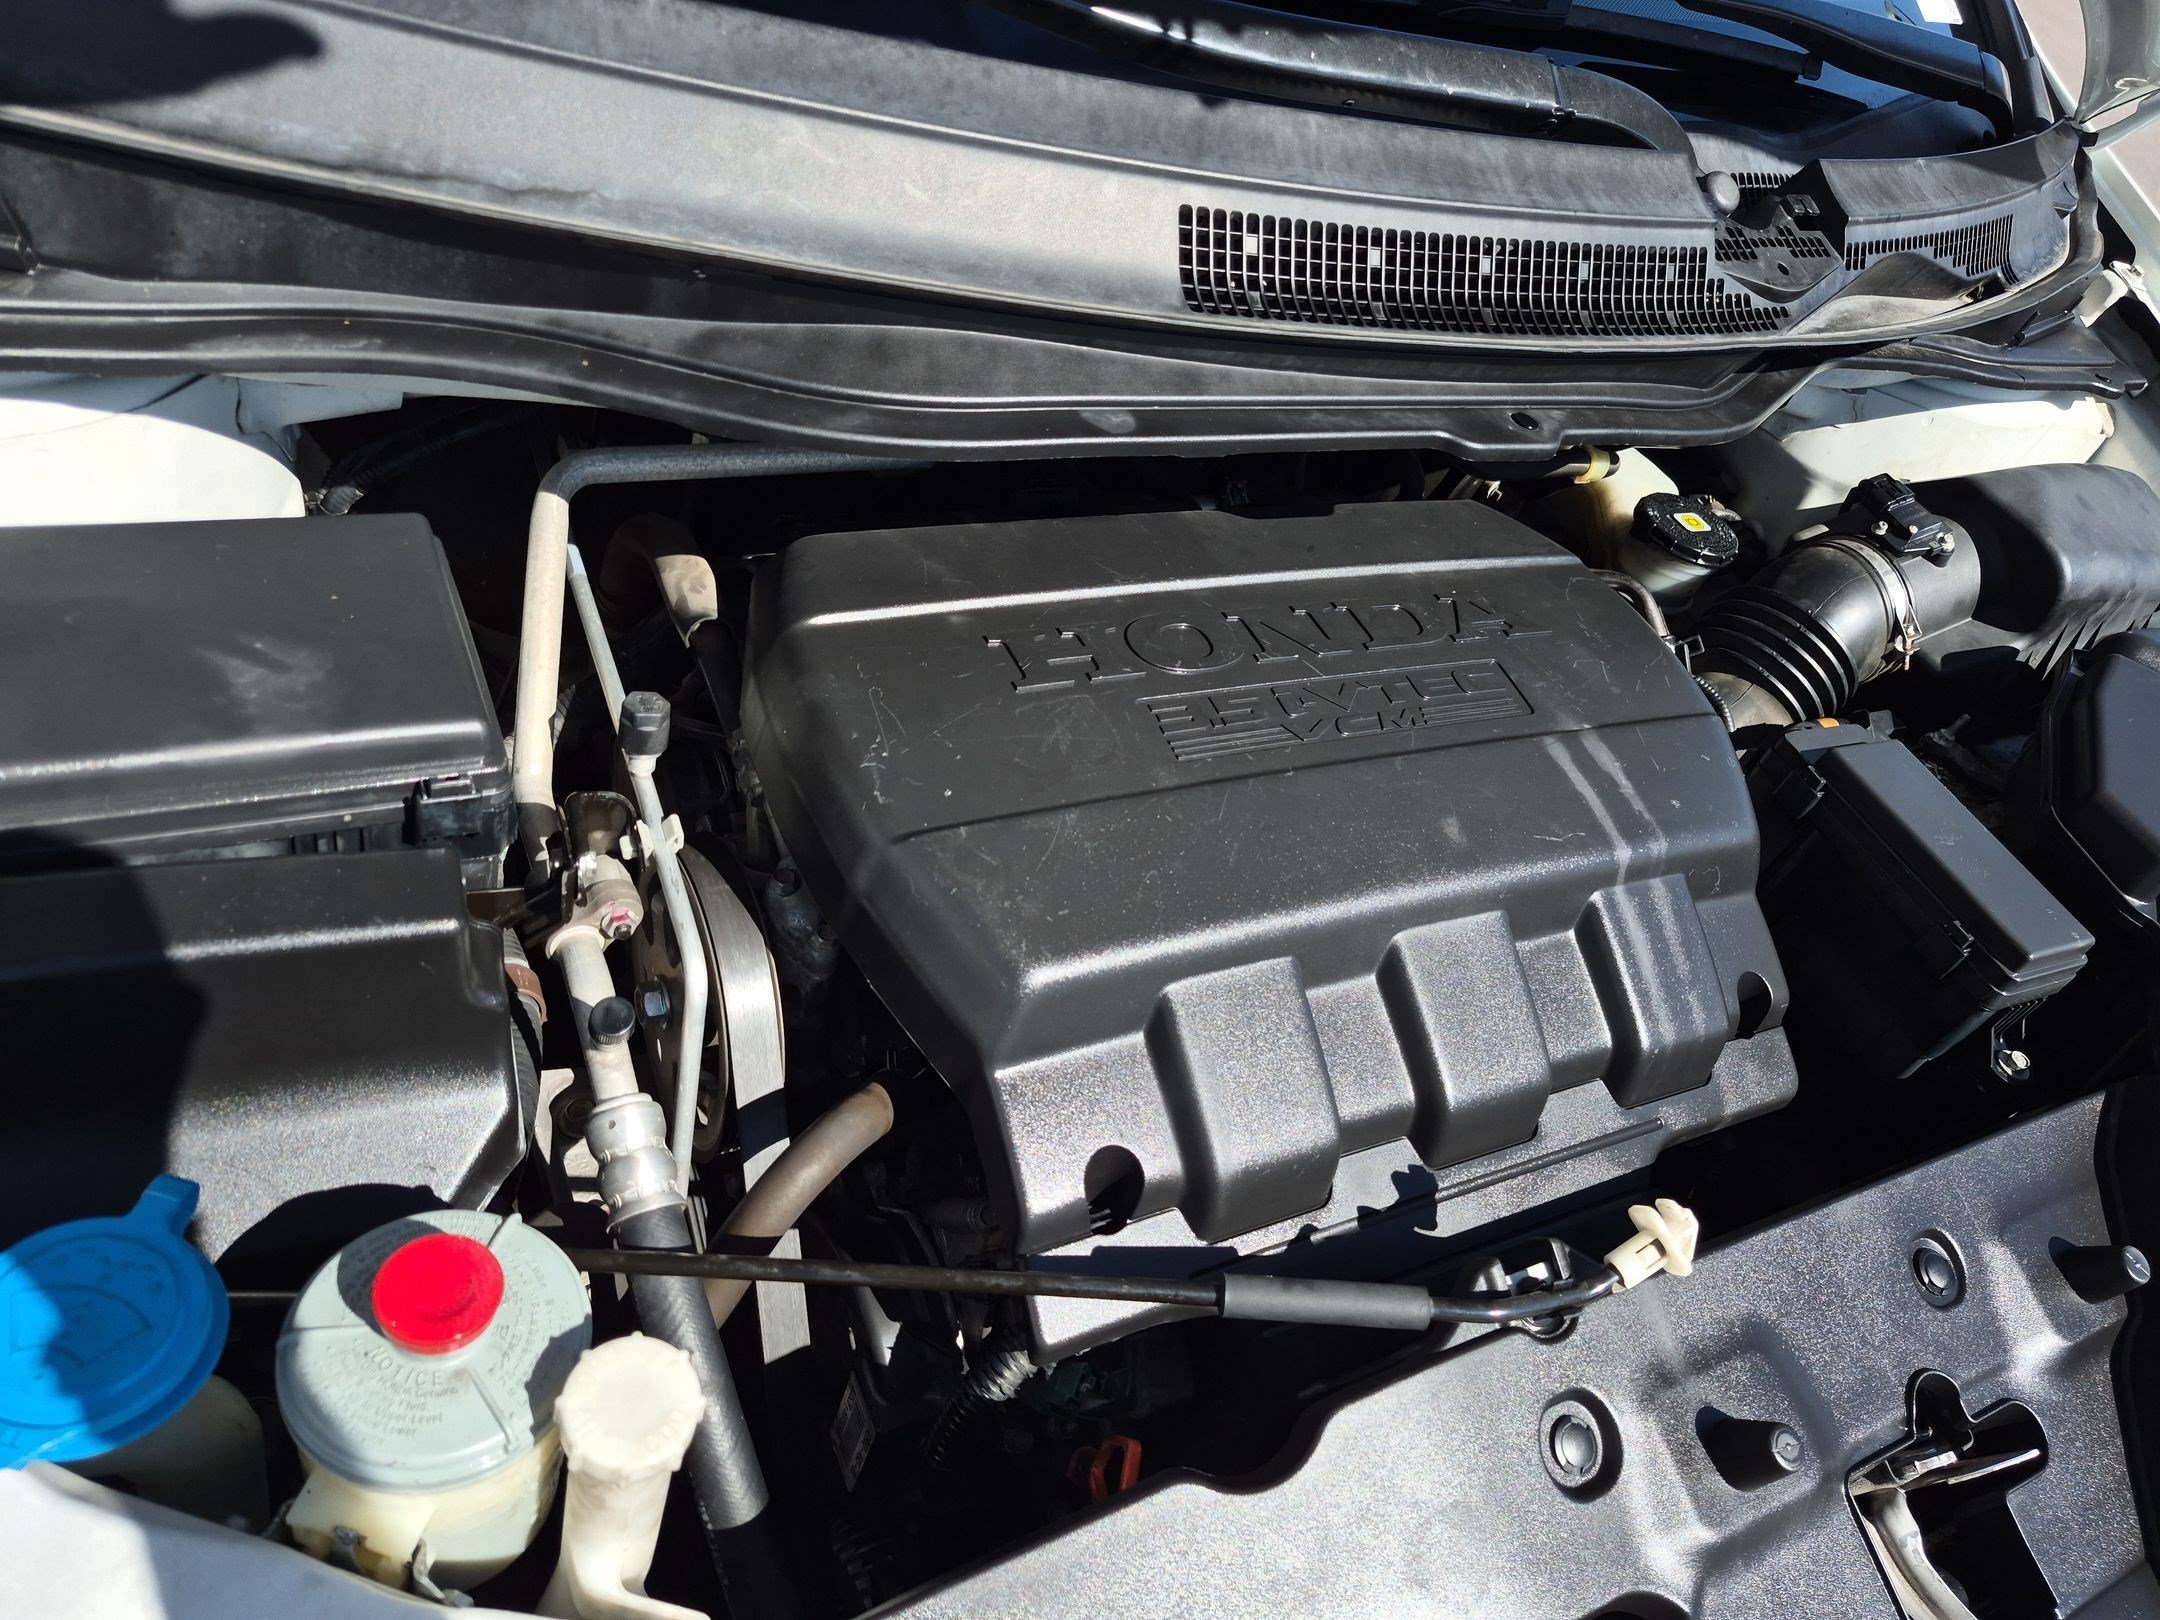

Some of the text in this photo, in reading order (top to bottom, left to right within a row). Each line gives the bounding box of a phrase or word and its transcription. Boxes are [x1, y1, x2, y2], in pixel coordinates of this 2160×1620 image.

[982, 594, 1553, 692] HONDA
[363, 1344, 445, 1387] NOTICE
[411, 1411, 443, 1425] Level
